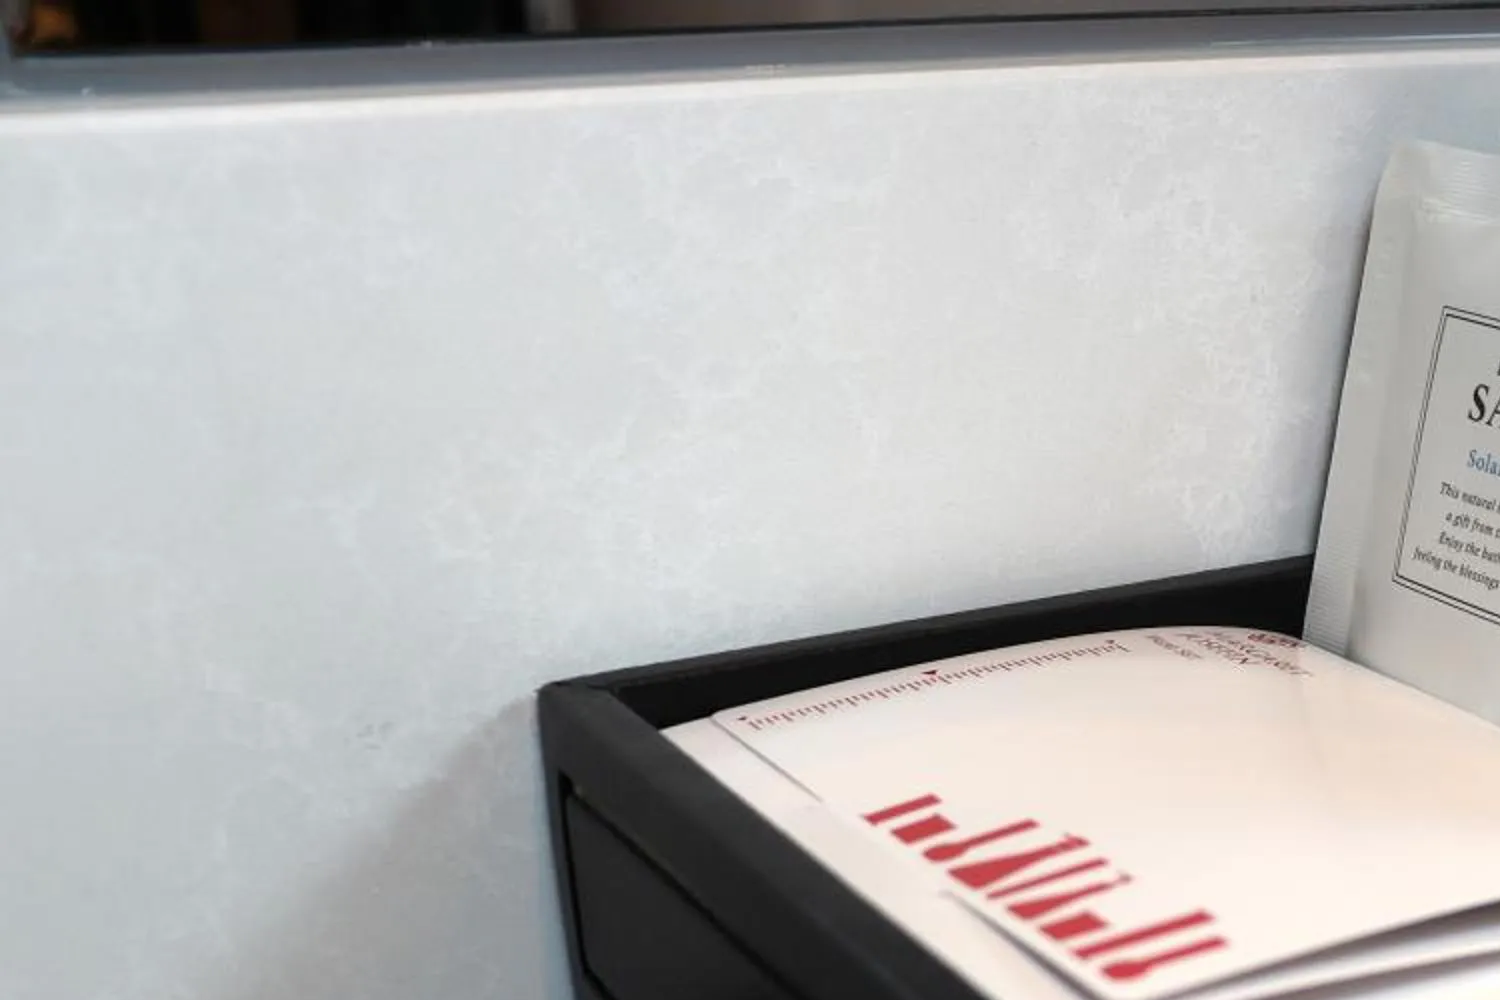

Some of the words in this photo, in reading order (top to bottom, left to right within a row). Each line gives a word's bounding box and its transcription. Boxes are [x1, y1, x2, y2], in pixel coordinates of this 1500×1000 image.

[1440, 481, 1460, 499] This
[1461, 492, 1497, 511] natural
[1445, 512, 1453, 522] a
[1452, 513, 1471, 529] gift
[1470, 518, 1494, 536] from
[1438, 531, 1463, 553] Enjoy
[1464, 542, 1481, 557] the
[1412, 546, 1442, 571] feeling
[1443, 559, 1459, 574] the
[1459, 563, 1500, 591] blessings
